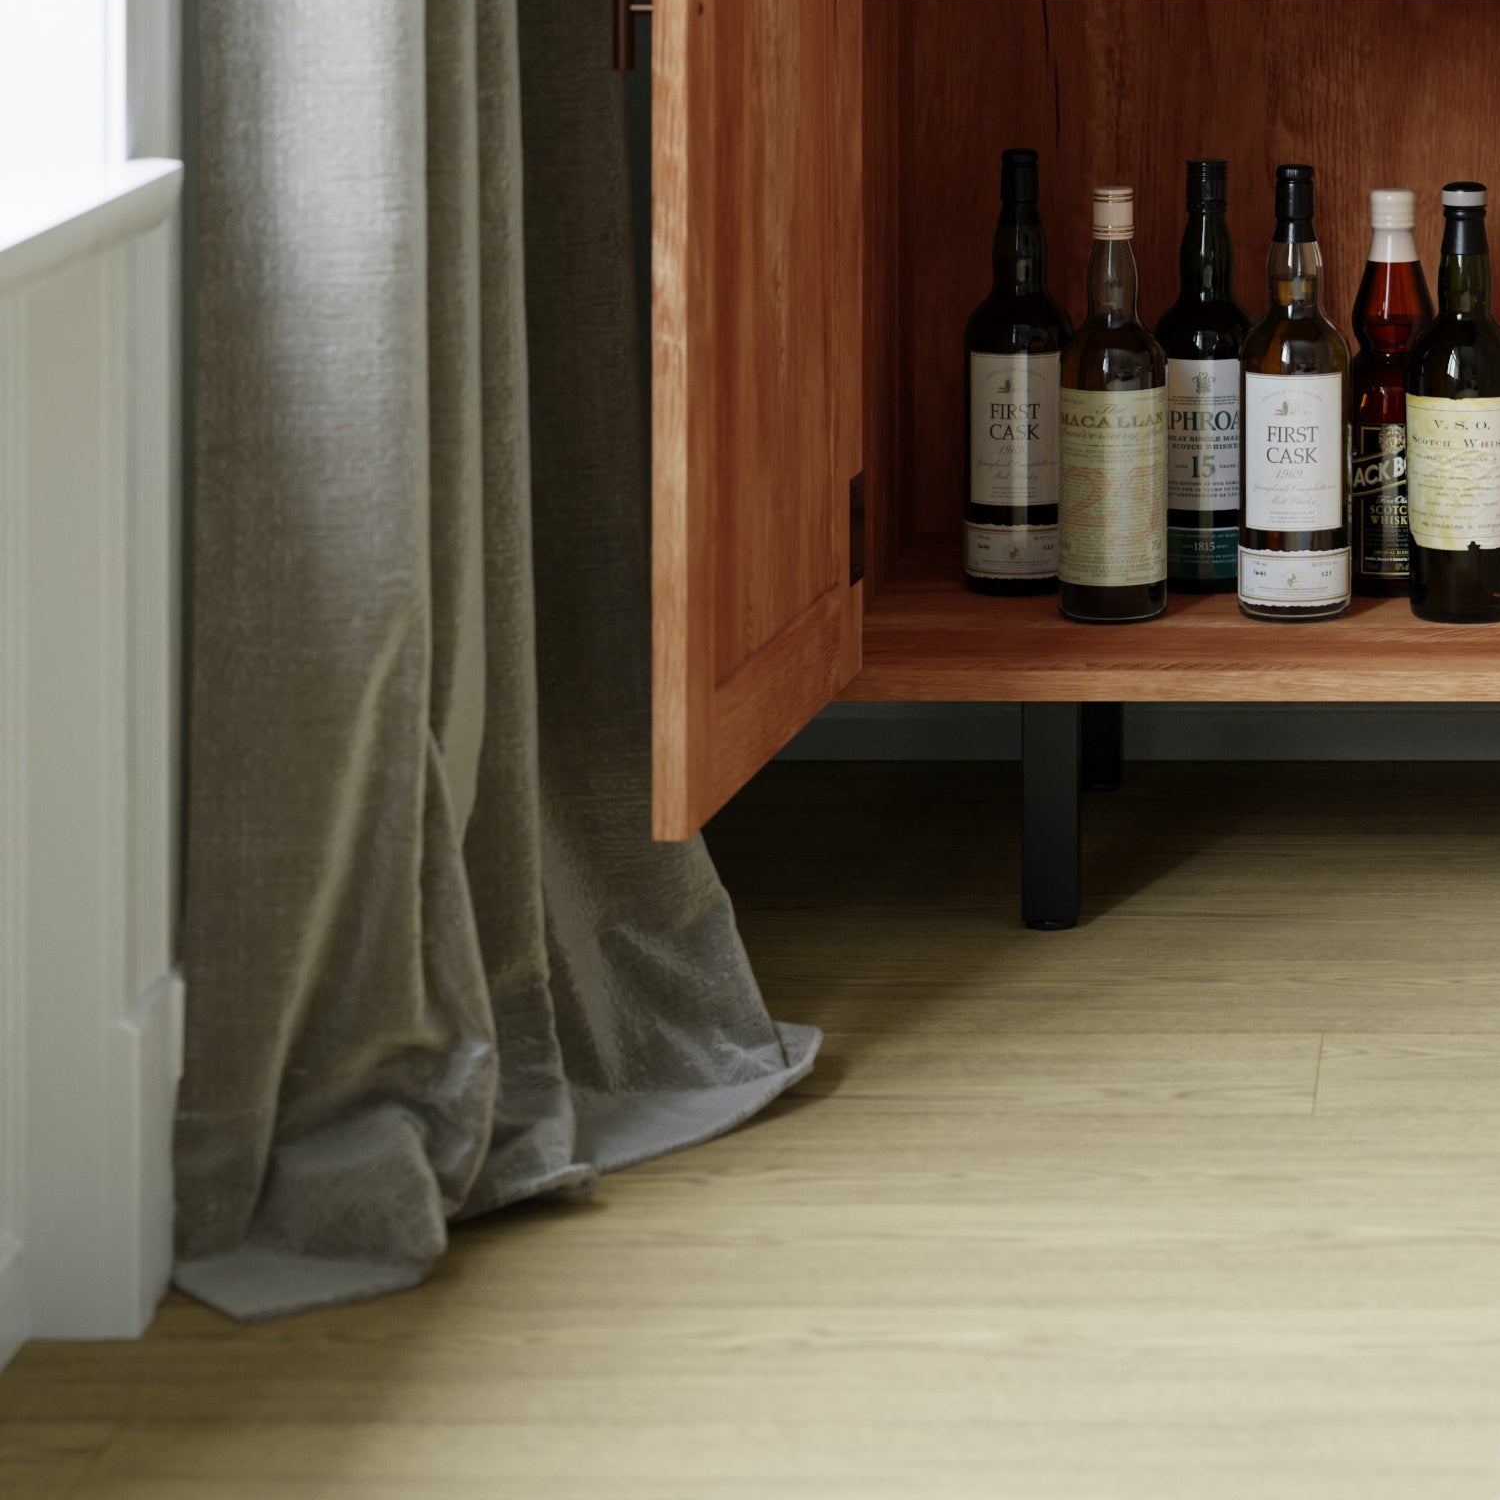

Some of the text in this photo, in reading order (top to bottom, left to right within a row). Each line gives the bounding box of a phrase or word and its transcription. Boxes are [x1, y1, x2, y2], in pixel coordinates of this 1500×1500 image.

[990, 403, 1040, 419] FIRST
[1060, 411, 1163, 428] MACALLAN
[1168, 410, 1238, 430] PHROA
[989, 423, 1040, 440] CASK
[1223, 434, 1239, 442] MAL
[1266, 425, 1318, 443] FIRST
[1172, 443, 1202, 451] SCOTCH
[1266, 447, 1318, 464] CASK
[1191, 455, 1216, 478] 15
[1276, 468, 1303, 480] 1969
[1353, 460, 1391, 489] ACK
[1369, 504, 1407, 515] SCOTC
[1370, 515, 1408, 525] WHISK
[1193, 541, 1216, 552] 1815
